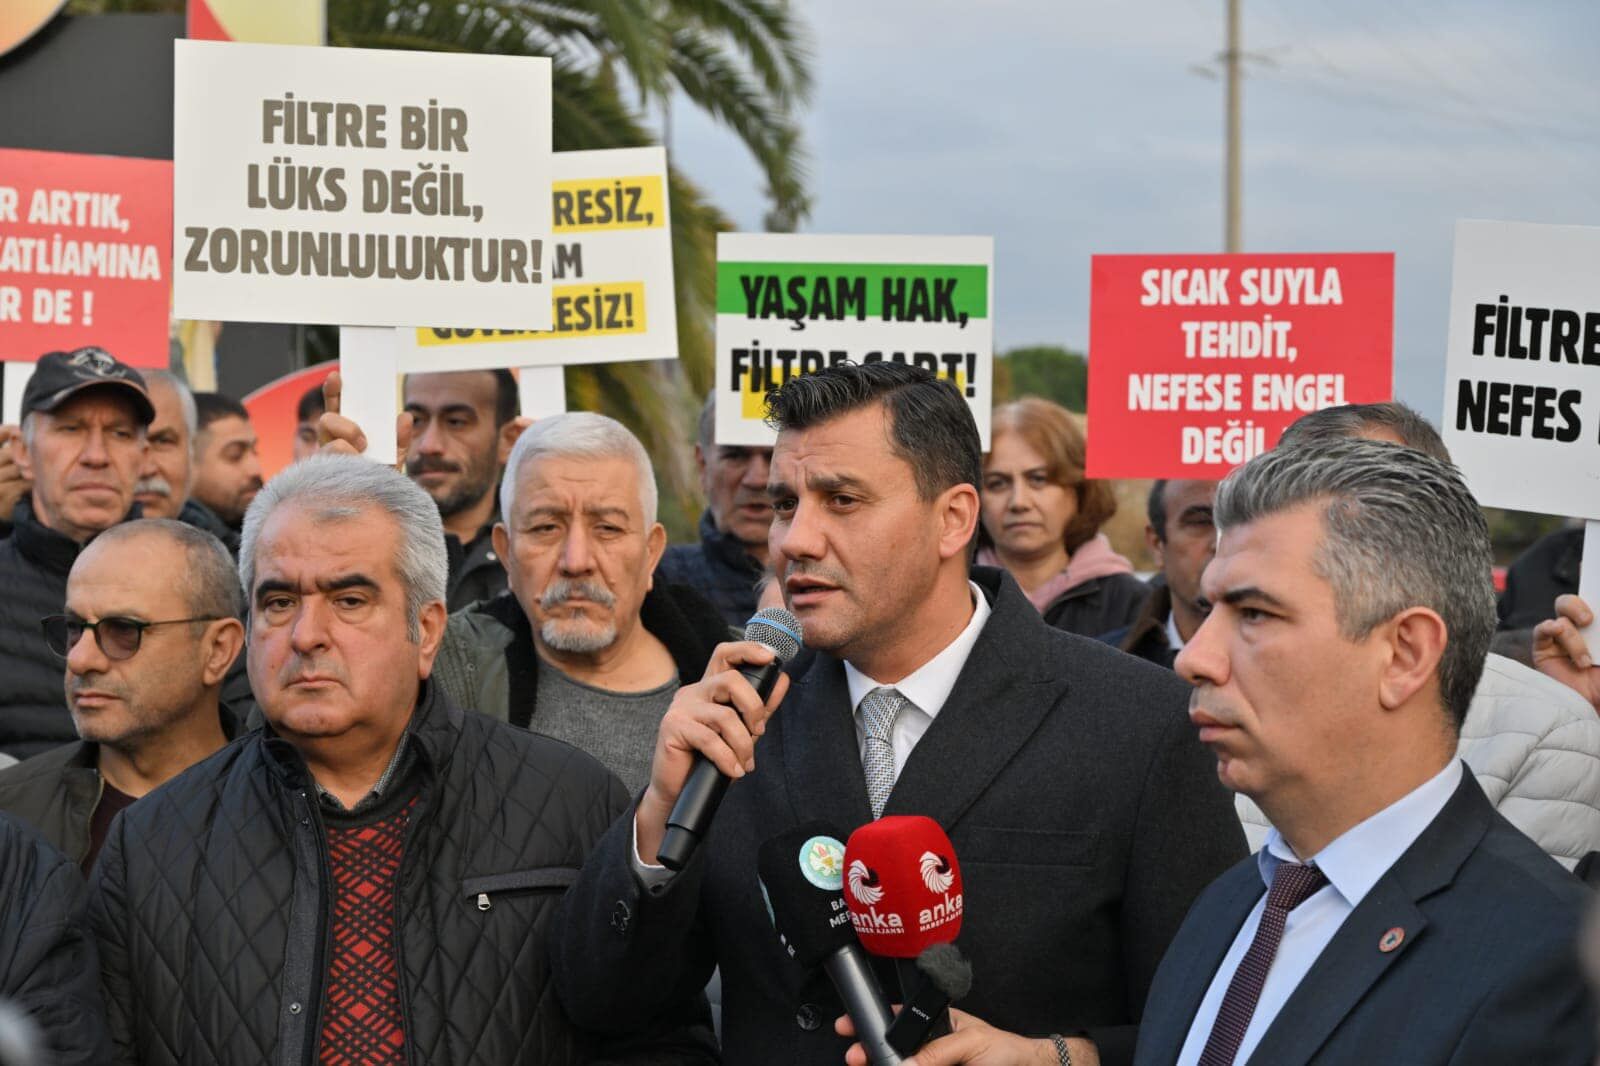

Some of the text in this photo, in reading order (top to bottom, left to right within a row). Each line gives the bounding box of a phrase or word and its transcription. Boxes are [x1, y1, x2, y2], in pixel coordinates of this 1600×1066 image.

[262, 92, 469, 152] FİLTRE BİR
[28, 188, 129, 234] ARTIK,
[247, 156, 484, 223] LÜKS DEĞİL,
[0, 233, 161, 281] ATLİAMINA
[184, 226, 543, 284] ZORUNLULUKTUR!
[32, 287, 72, 325] DE
[740, 275, 968, 331] YAŞAM HAK,
[1140, 267, 1343, 307] SICAK SUYLA
[1181, 314, 1298, 363] TEHDİT,
[1472, 294, 1600, 366] FİLTRE
[1127, 373, 1350, 412] NEFESE ENGEL
[1456, 379, 1582, 443] NEFES
[851, 906, 903, 928] anka
[919, 892, 963, 924] anka
